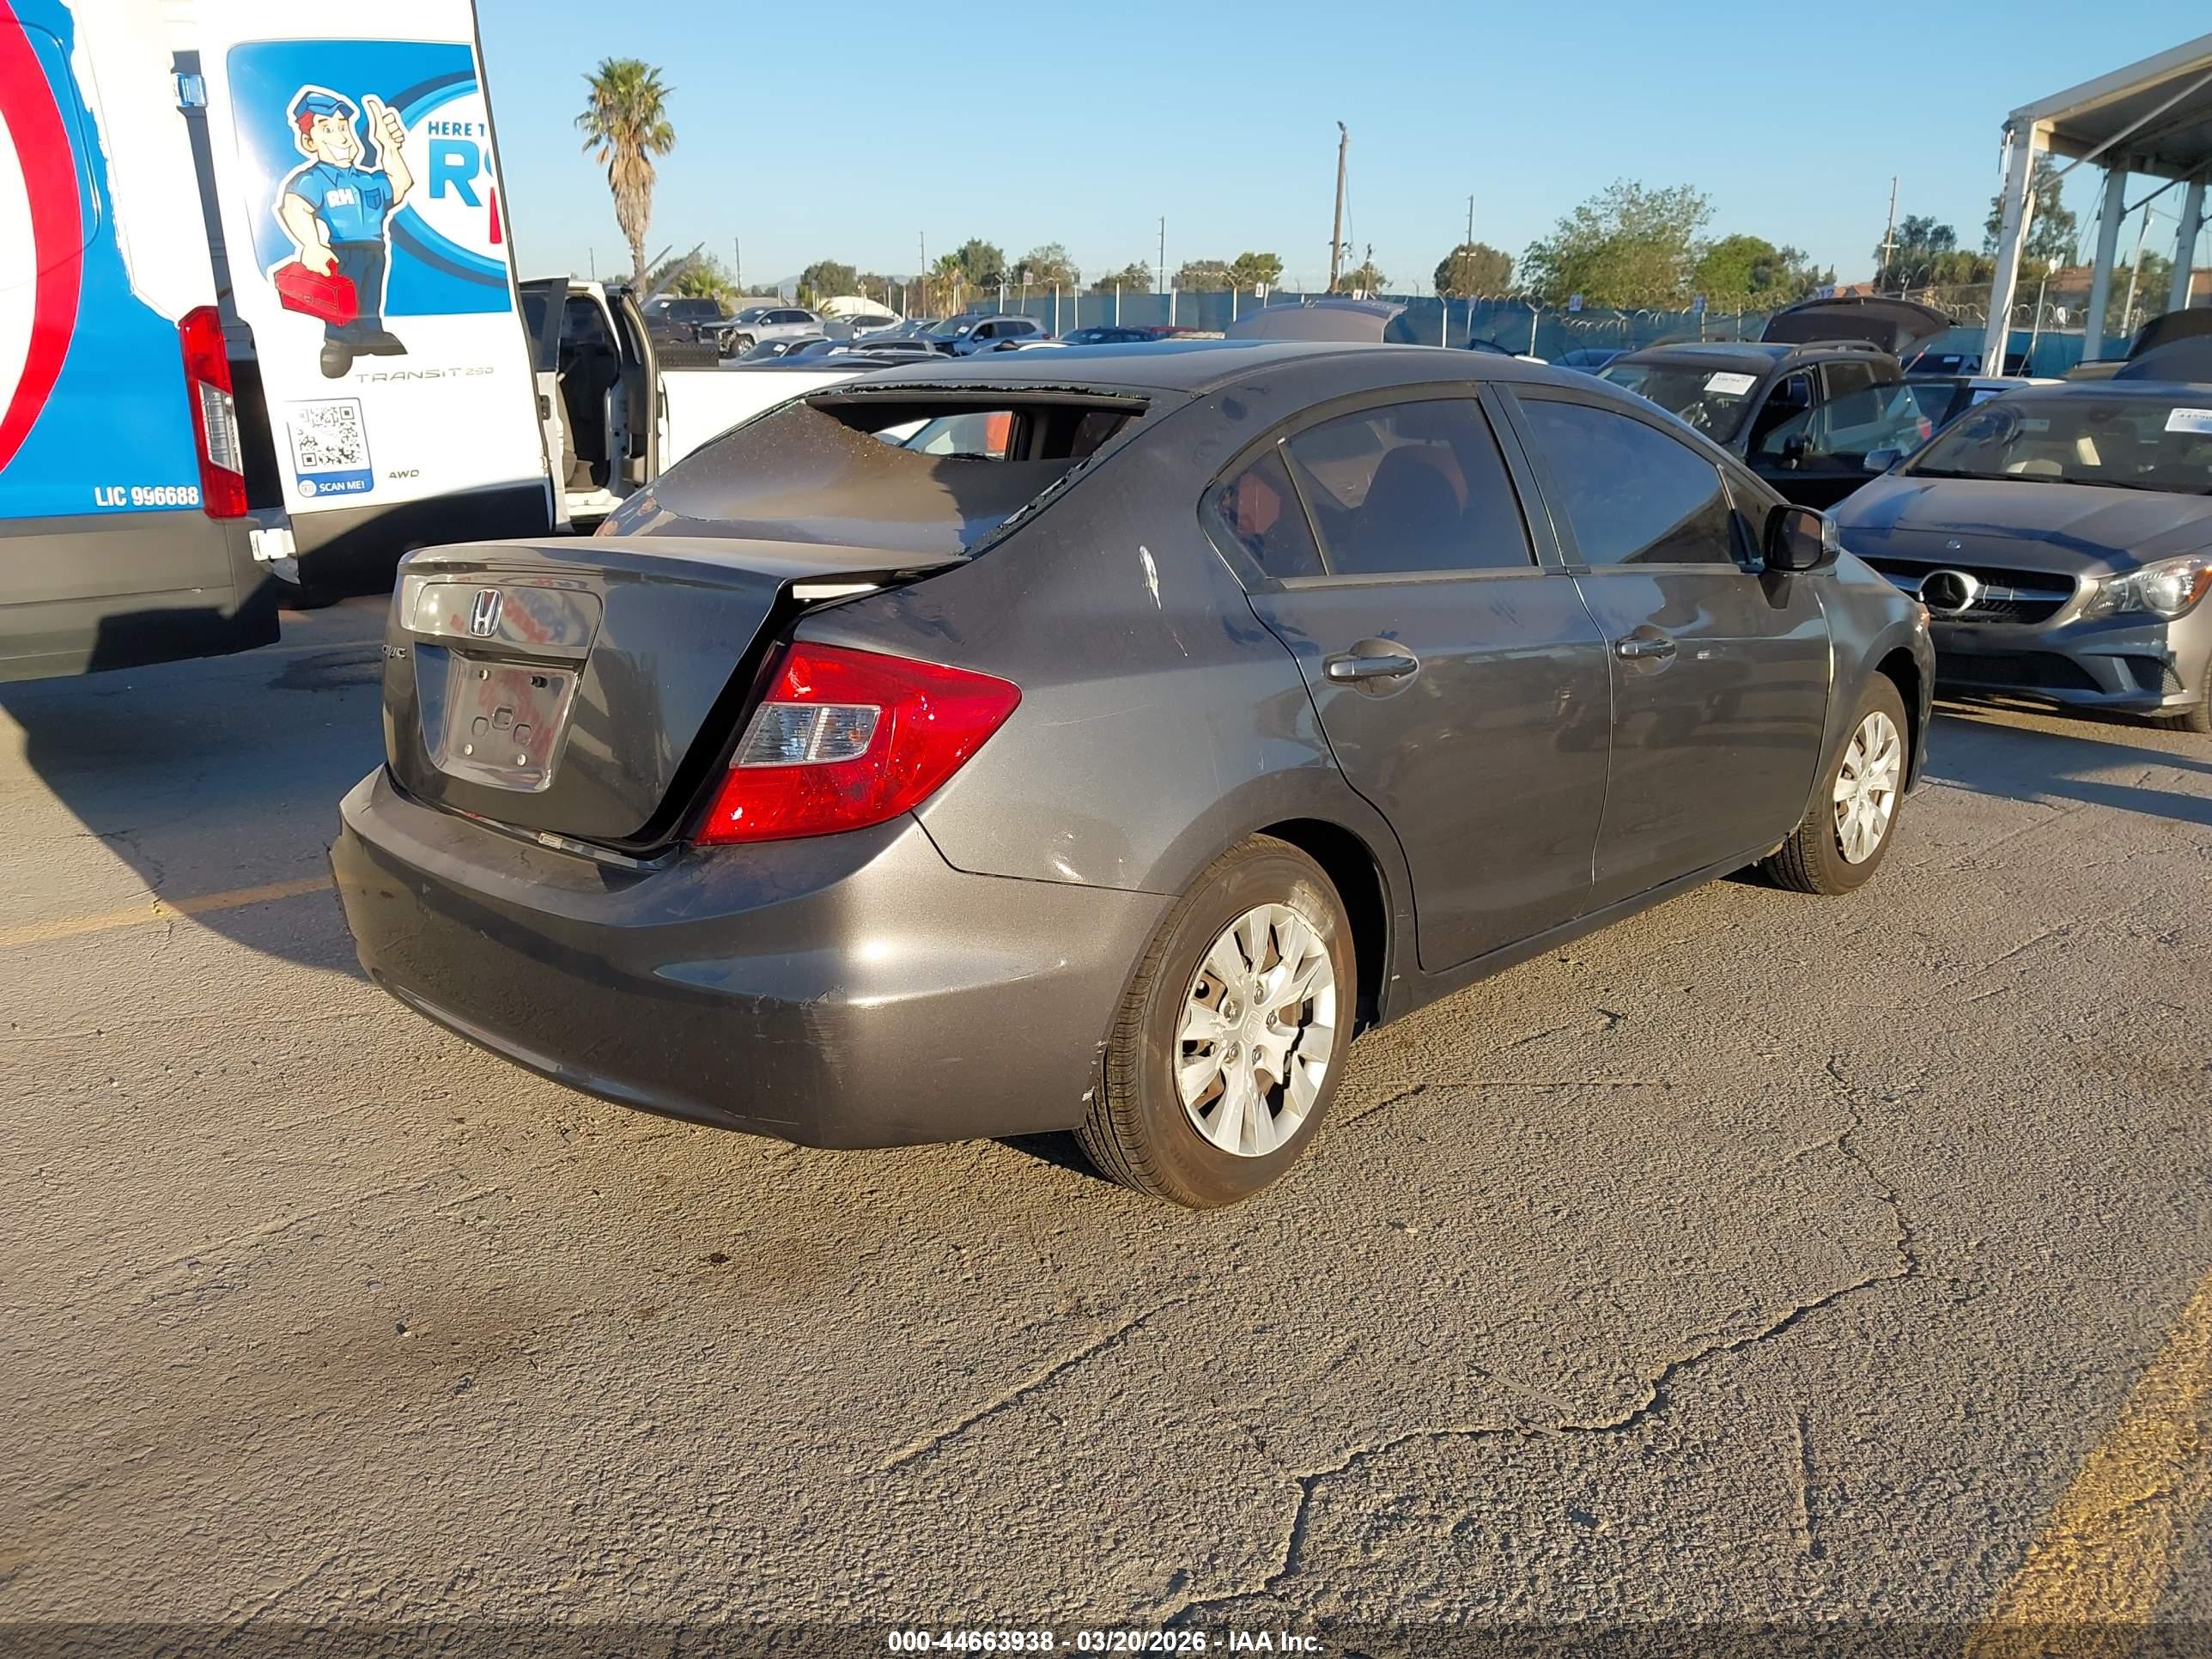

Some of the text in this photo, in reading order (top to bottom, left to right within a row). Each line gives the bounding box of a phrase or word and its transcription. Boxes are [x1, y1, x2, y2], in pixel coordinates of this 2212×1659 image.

[428, 121, 473, 137] HERE
[355, 366, 495, 384] TRANSIT 250
[388, 469, 420, 479] AWD
[319, 479, 366, 493] SCAN ME!
[94, 485, 199, 507] LIC 996688
